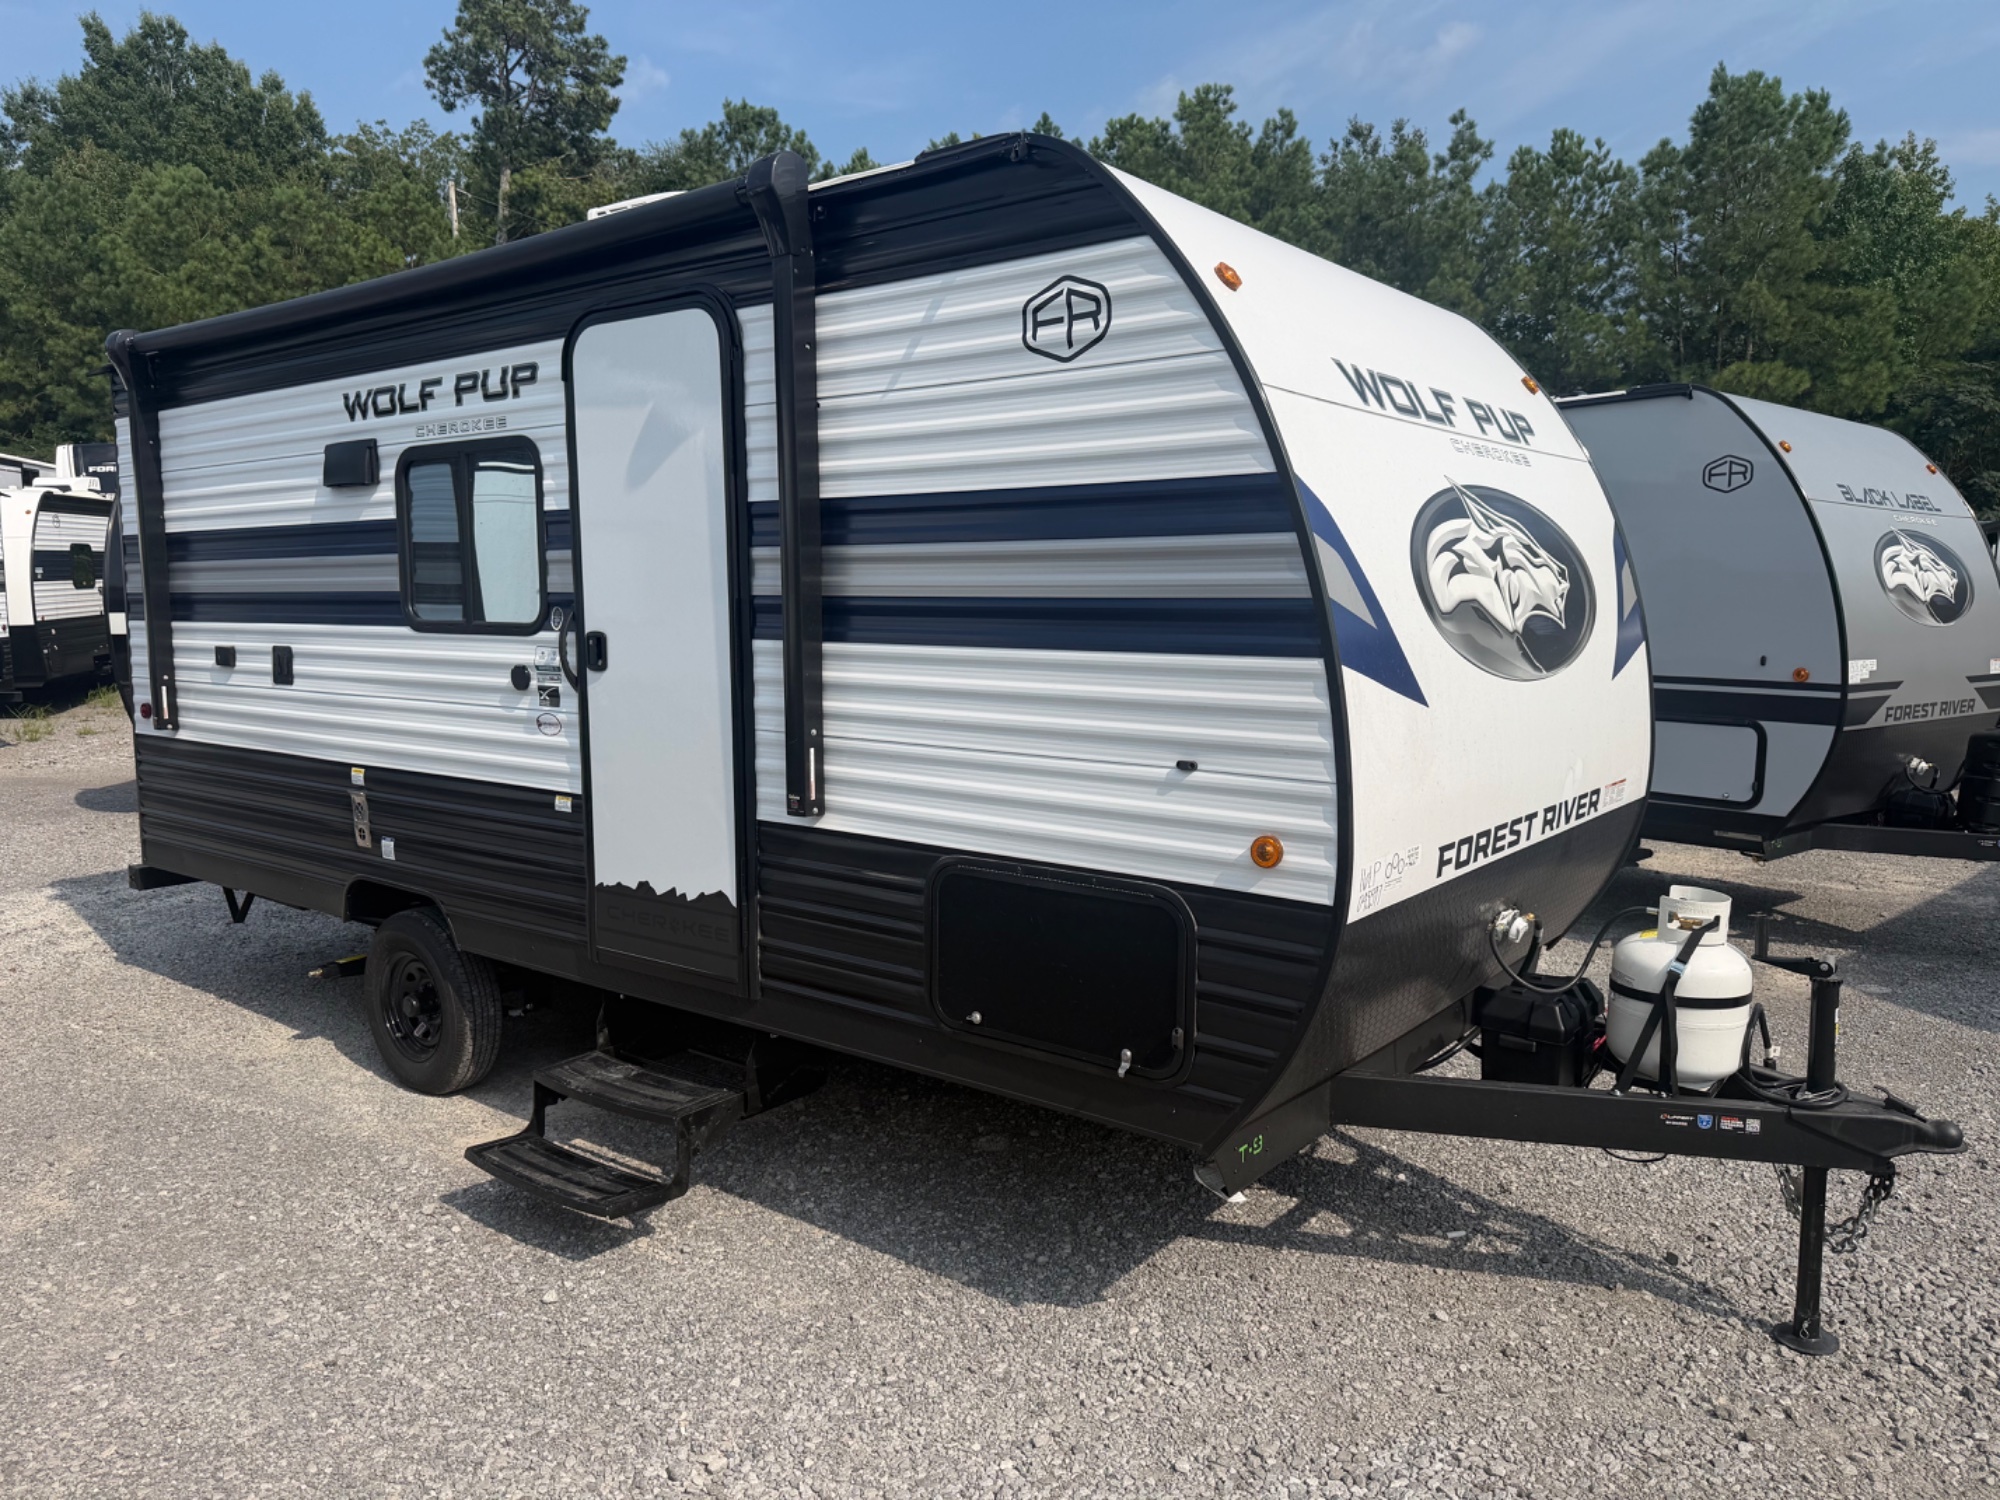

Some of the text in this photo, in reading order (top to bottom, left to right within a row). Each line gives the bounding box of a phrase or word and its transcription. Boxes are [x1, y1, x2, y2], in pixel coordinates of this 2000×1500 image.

[342, 361, 540, 422] WOLF PUP
[1330, 356, 1536, 446] WOLF PUP
[415, 415, 508, 438] CHEROKEE
[1450, 437, 1532, 467] CHEROKEE
[88, 465, 117, 473] FOR
[1836, 483, 1943, 512] BLACK LABEL
[1884, 698, 1976, 722] FOREST RIVER
[1436, 811, 1539, 878] FOREST
[1541, 787, 1601, 835] RIVER
